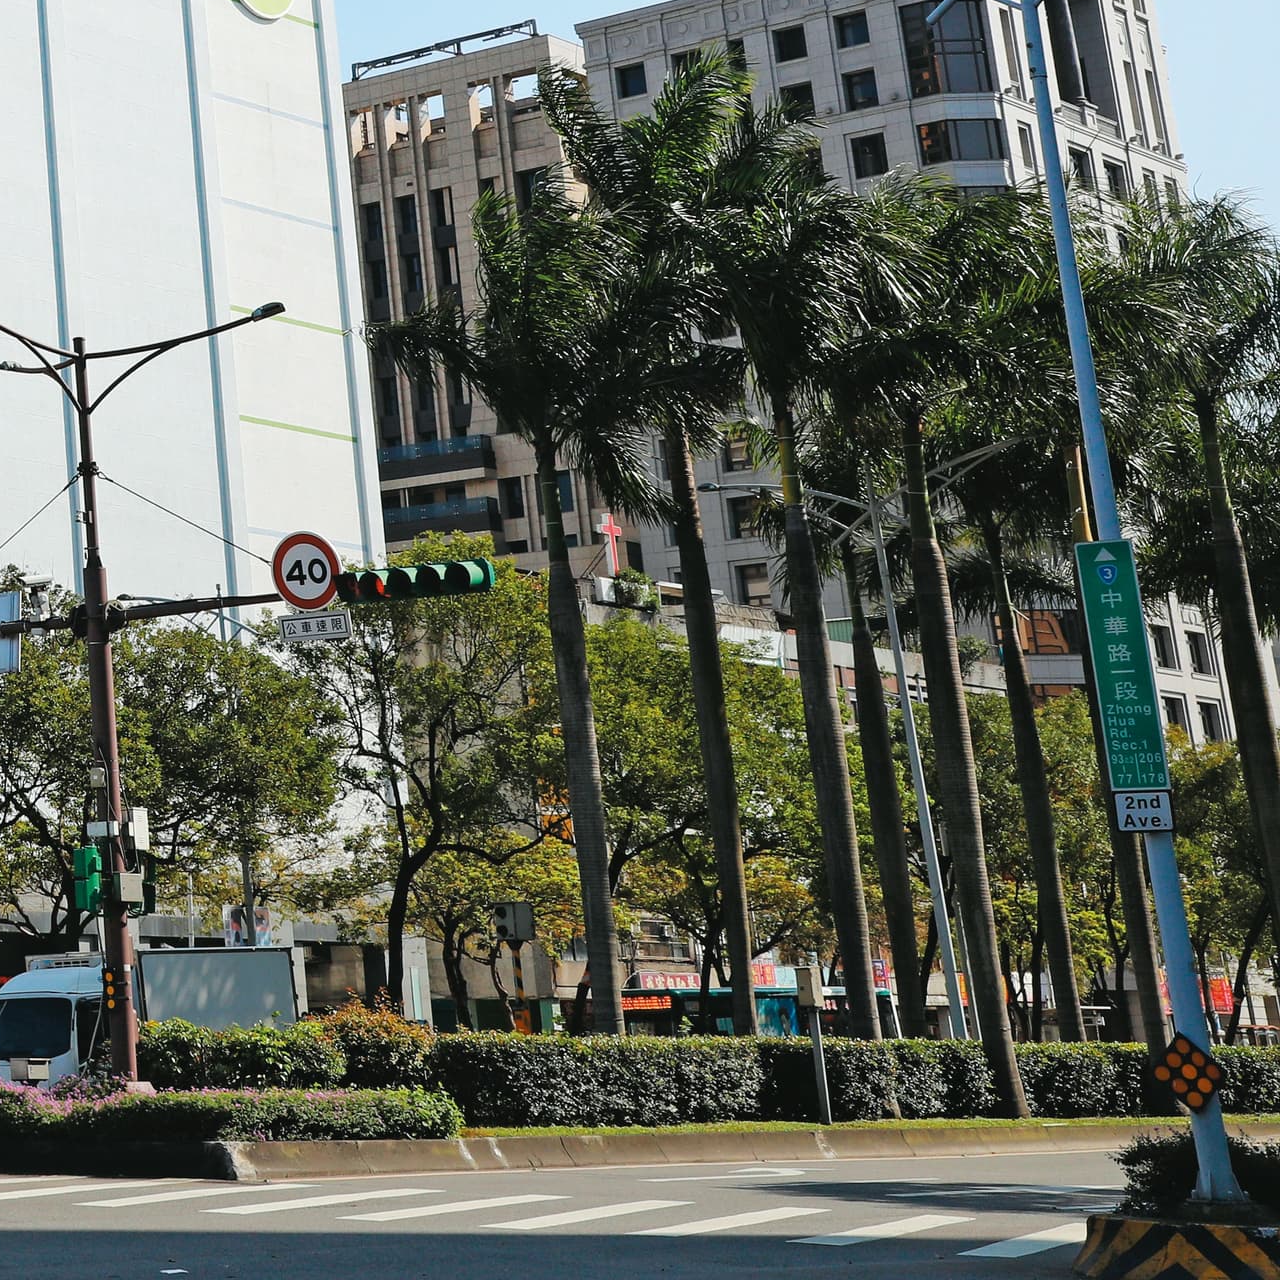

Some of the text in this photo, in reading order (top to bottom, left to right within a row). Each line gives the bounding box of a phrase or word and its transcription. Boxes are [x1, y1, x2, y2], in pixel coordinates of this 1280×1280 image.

[286, 558, 327, 586] 40
[1103, 568, 1113, 579] 3
[286, 617, 345, 635] 公車速限
[1100, 588, 1139, 701] 中華路一段
[1106, 704, 1152, 716] Zhong
[1108, 717, 1136, 727] Hua
[1110, 728, 1132, 738] Rd.
[1112, 739, 1148, 751] Sec.1
[1139, 752, 1162, 763] 206
[1117, 773, 1133, 784] 77
[1141, 772, 1165, 784] 178
[1125, 795, 1161, 810] 2nd
[1124, 813, 1168, 828] Ave.
